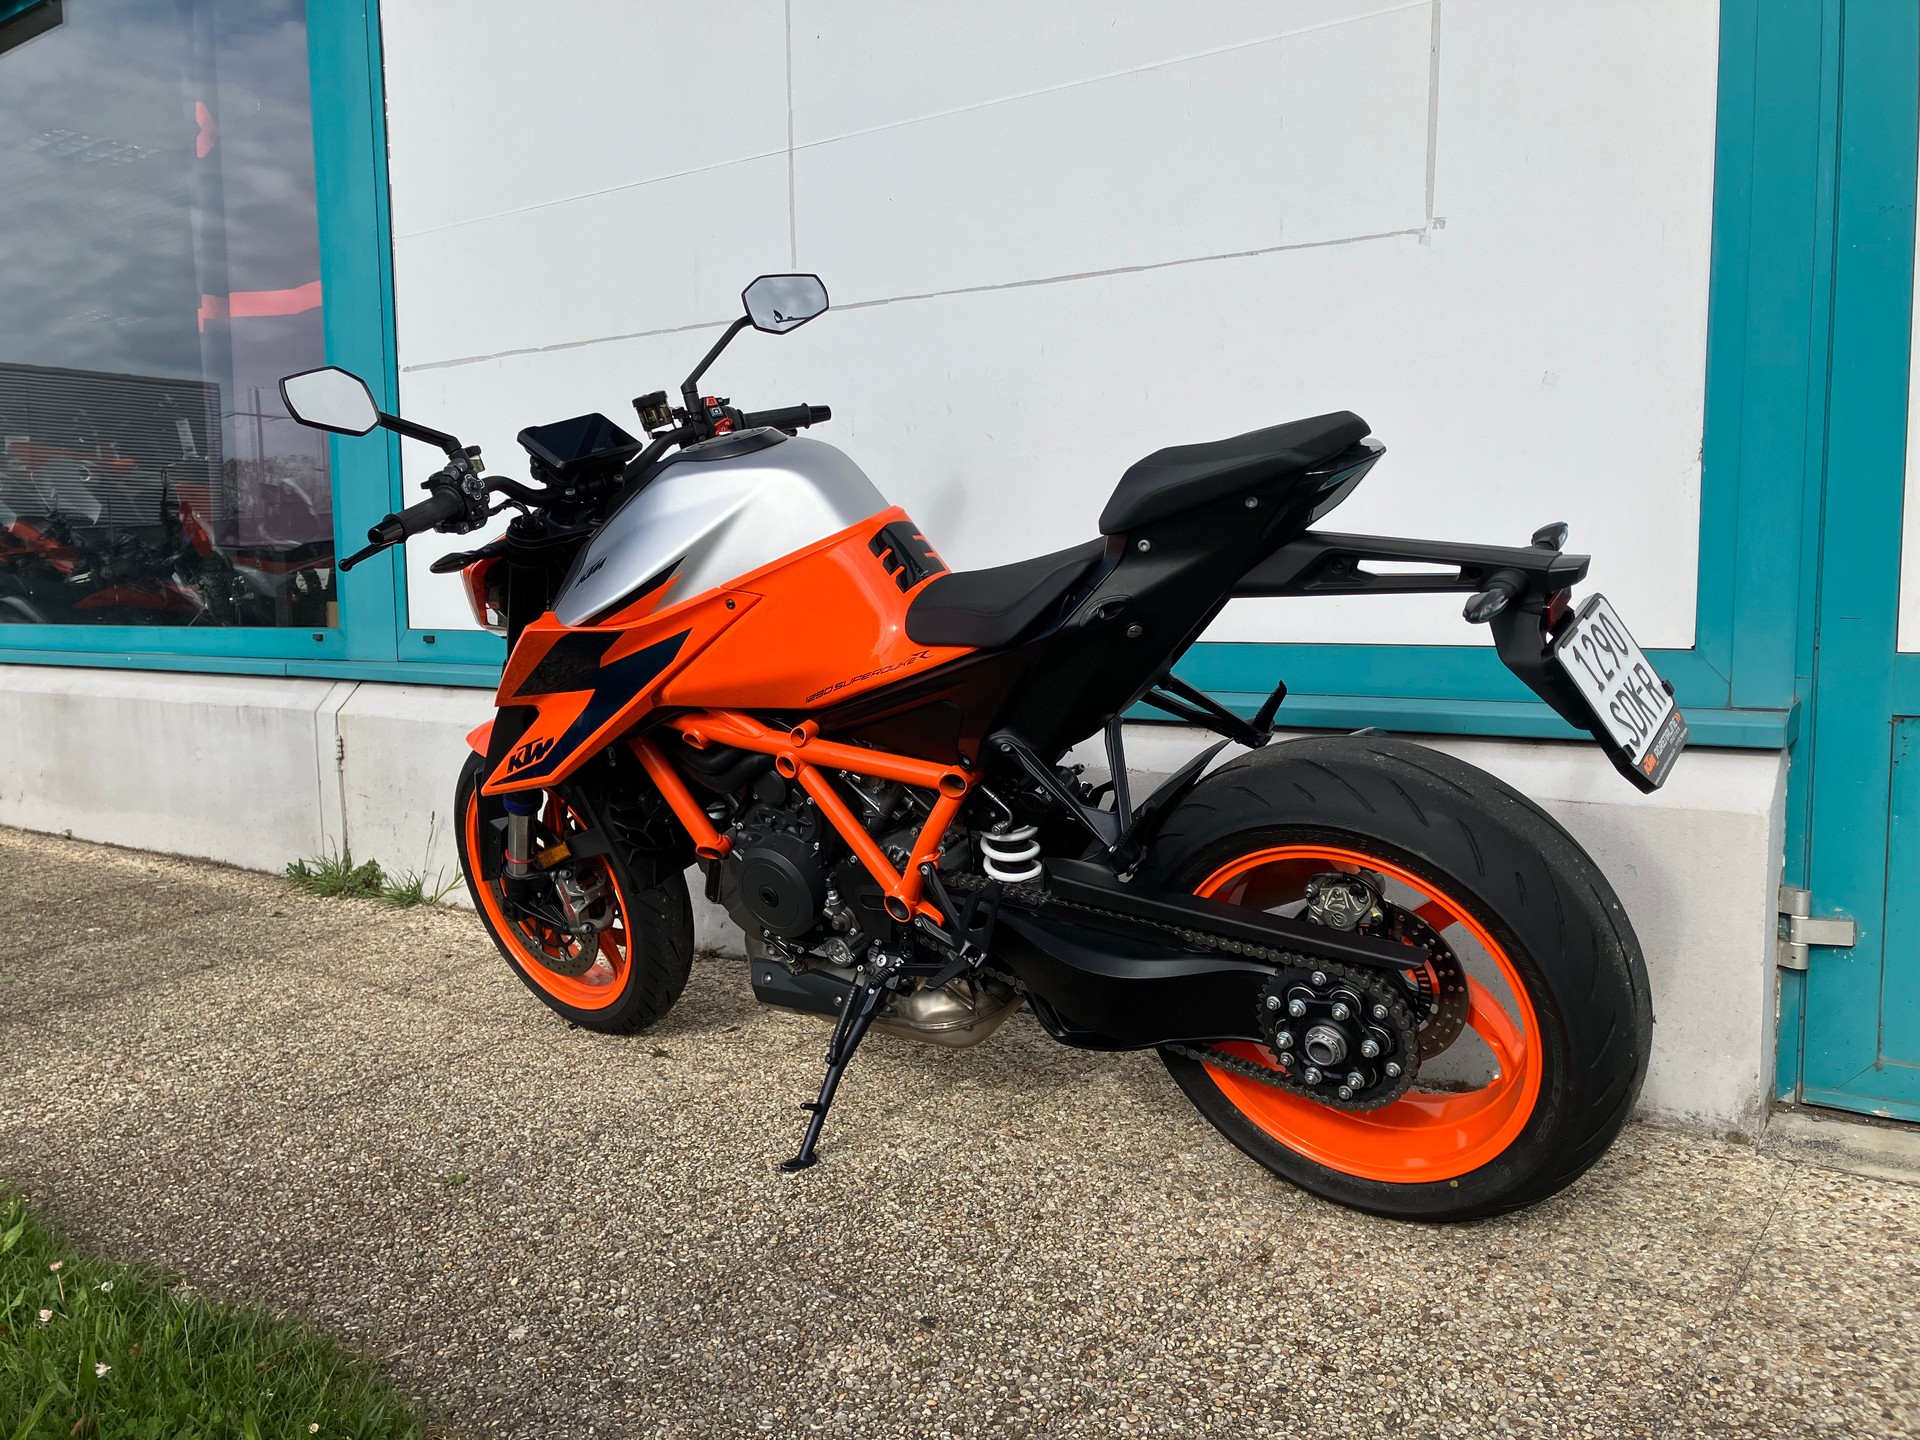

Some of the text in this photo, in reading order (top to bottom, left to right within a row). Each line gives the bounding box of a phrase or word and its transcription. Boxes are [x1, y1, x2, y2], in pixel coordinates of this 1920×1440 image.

[575, 556, 608, 589] KTM
[1572, 612, 1629, 692] 1290
[805, 685, 834, 704] 1290
[1609, 662, 1667, 748] SDK-R
[507, 736, 555, 775] KTM
